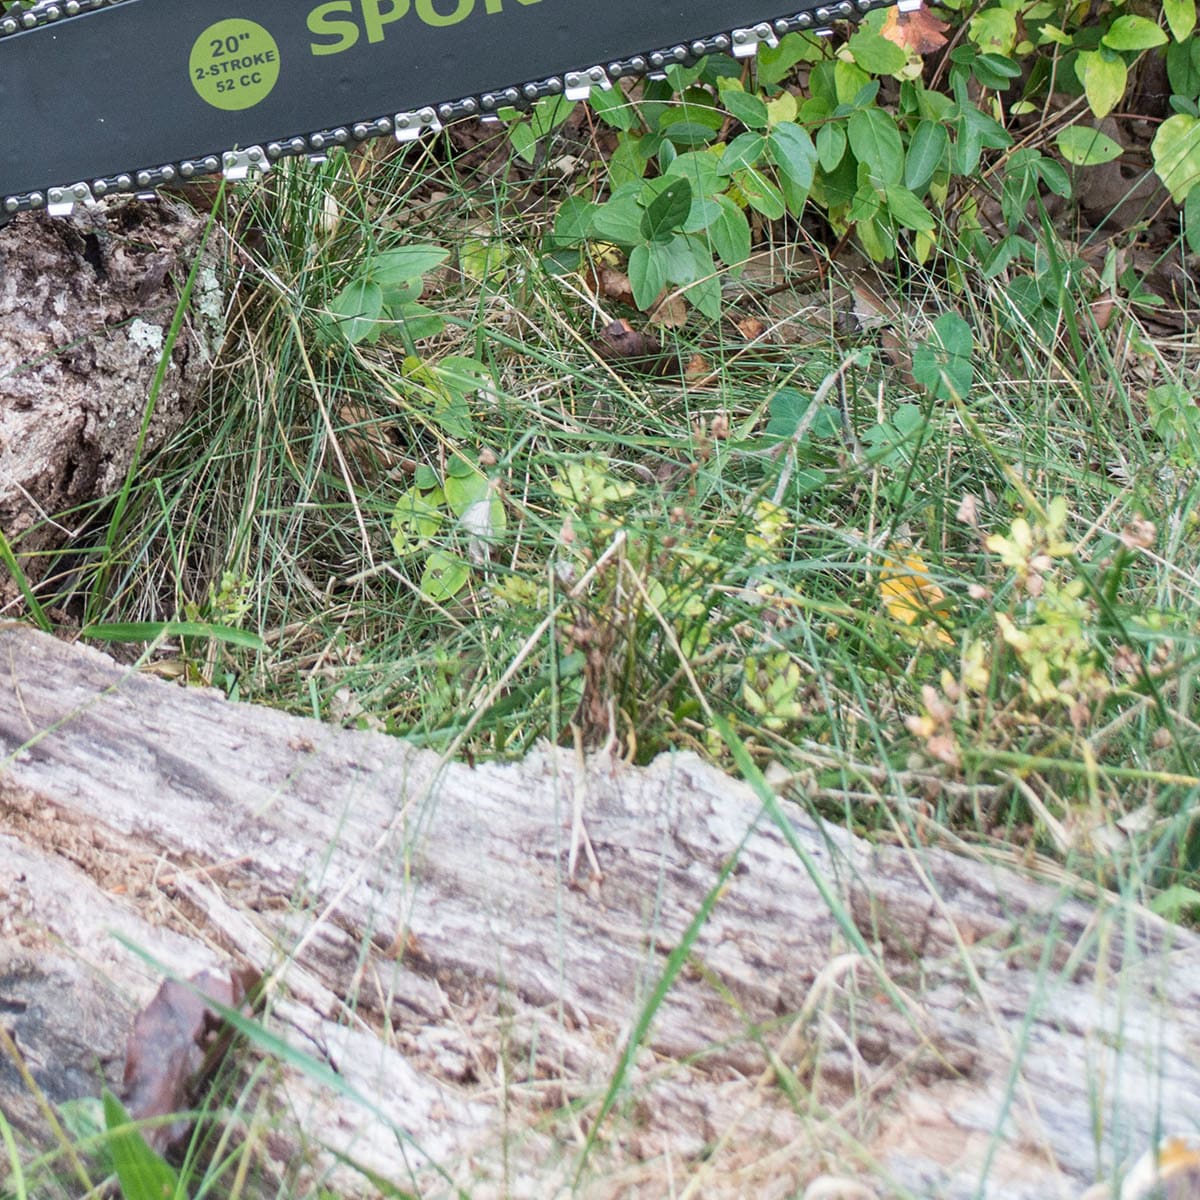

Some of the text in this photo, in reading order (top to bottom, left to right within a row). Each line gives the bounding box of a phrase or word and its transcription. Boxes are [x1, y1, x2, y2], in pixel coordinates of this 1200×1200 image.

[210, 32, 251, 58] 20"
[195, 50, 276, 80] 2-STROKE
[216, 72, 262, 93] 52 CC
